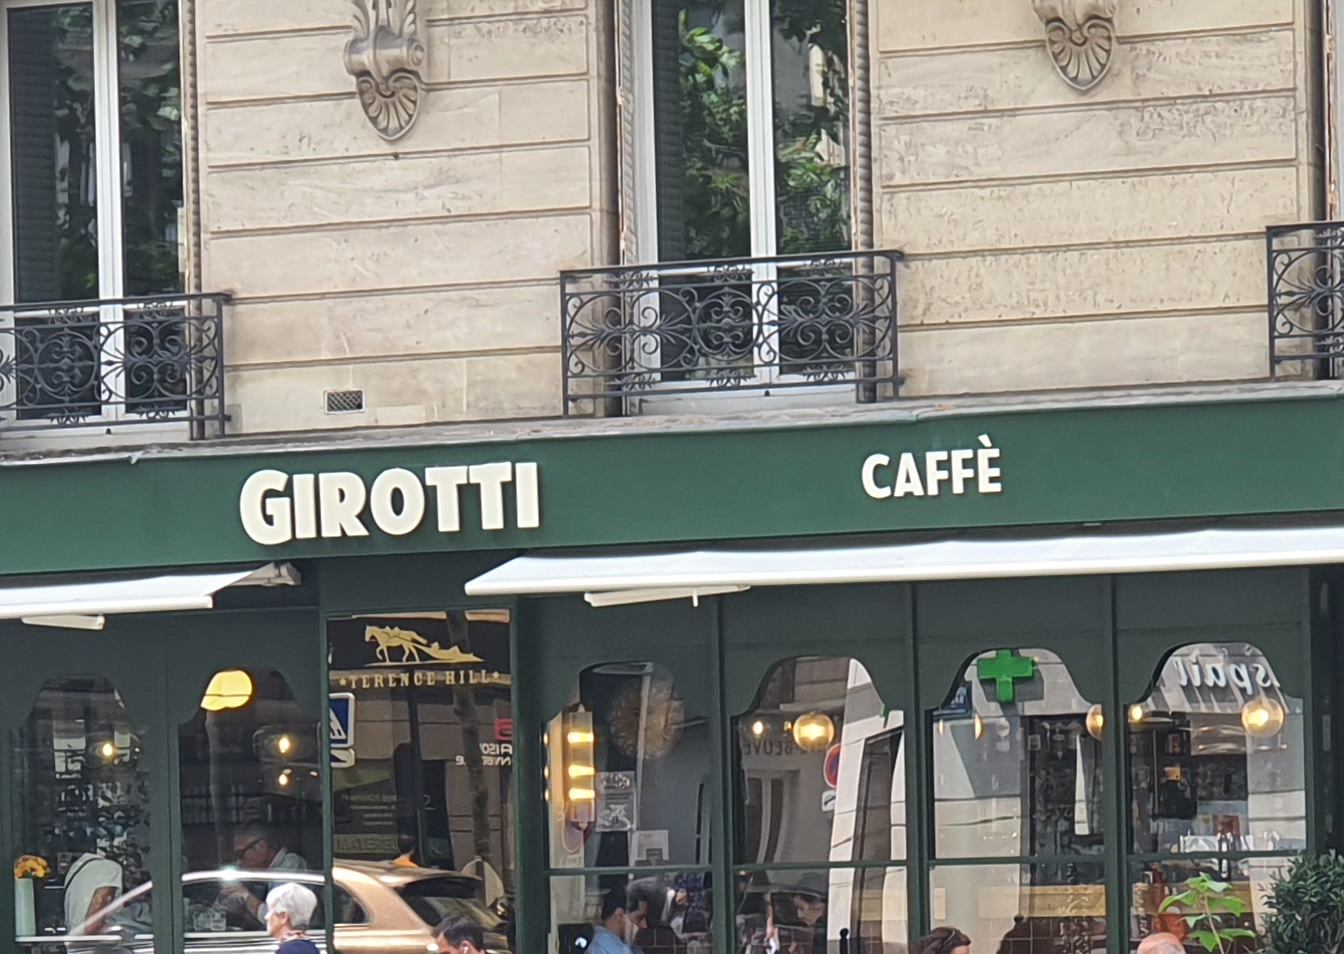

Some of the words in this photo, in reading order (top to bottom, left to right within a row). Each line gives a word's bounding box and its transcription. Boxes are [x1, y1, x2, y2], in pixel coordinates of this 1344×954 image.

[861, 434, 1002, 499] CAFFÈ
[239, 461, 540, 546] GIROTTI
[349, 671, 436, 689] TERENCE
[445, 669, 490, 685] HILL
